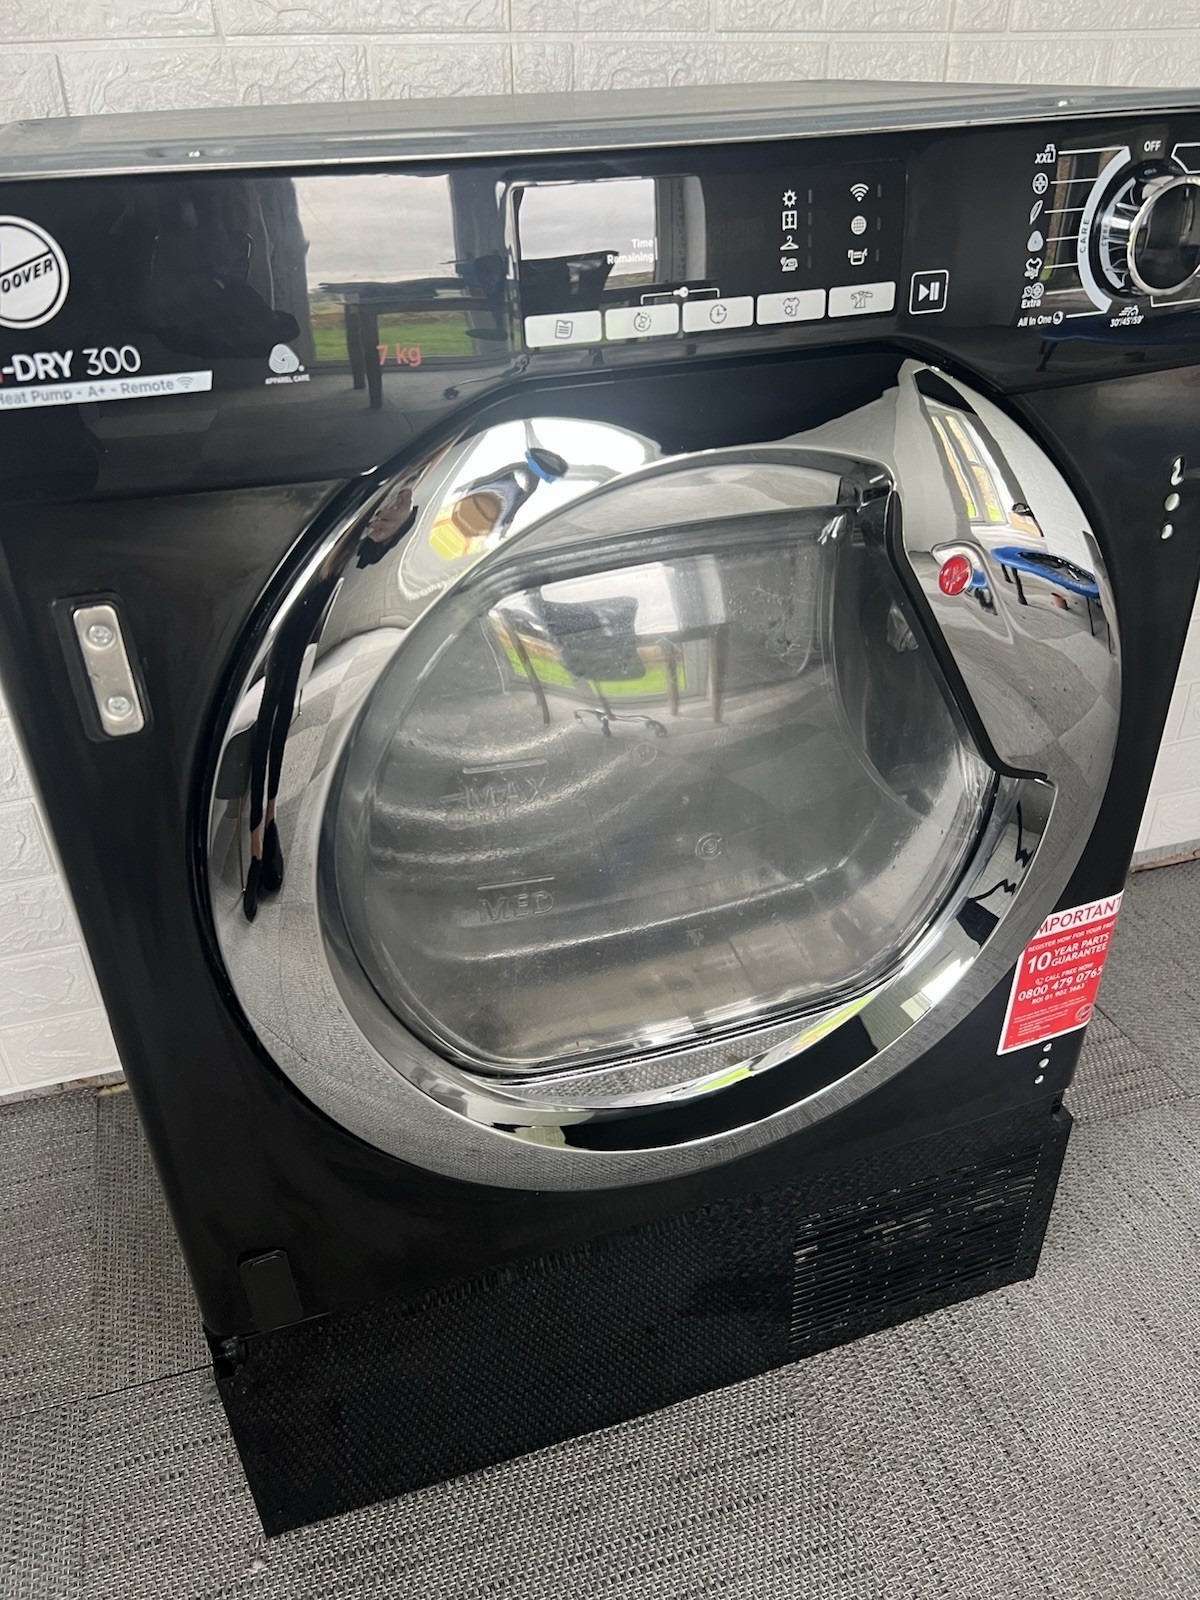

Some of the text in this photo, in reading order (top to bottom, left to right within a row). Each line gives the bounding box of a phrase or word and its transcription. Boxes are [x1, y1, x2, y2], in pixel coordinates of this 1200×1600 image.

[1143, 140, 1161, 152] OFF
[631, 238, 653, 249] Time
[1079, 218, 1090, 254] CARE
[607, 252, 654, 265] Remaining
[1, 258, 53, 293] OOVER
[1021, 299, 1042, 309] Extra
[1017, 317, 1028, 328] All
[1037, 315, 1053, 325] One
[0, 344, 142, 382] -DRY 300
[376, 342, 422, 367] 7 kg
[31, 389, 72, 403] Pump
[87, 386, 106, 398] A+
[121, 380, 174, 395] Remote
[464, 776, 549, 810] MAX
[479, 890, 554, 922] MED
[1038, 896, 1123, 934] MPORTANT
[1028, 940, 1056, 952] REGISTER
[1057, 934, 1072, 944] NOW
[1072, 931, 1085, 940] FOR
[1086, 925, 1102, 935] YOUR
[1054, 932, 1110, 956] YEAR PARTS
[1028, 951, 1052, 974] 10
[1050, 941, 1108, 967] GUARANTEE
[1017, 965, 1103, 1001] 0800 479 0765
[1044, 962, 1094, 982] CALL FREE NOW
